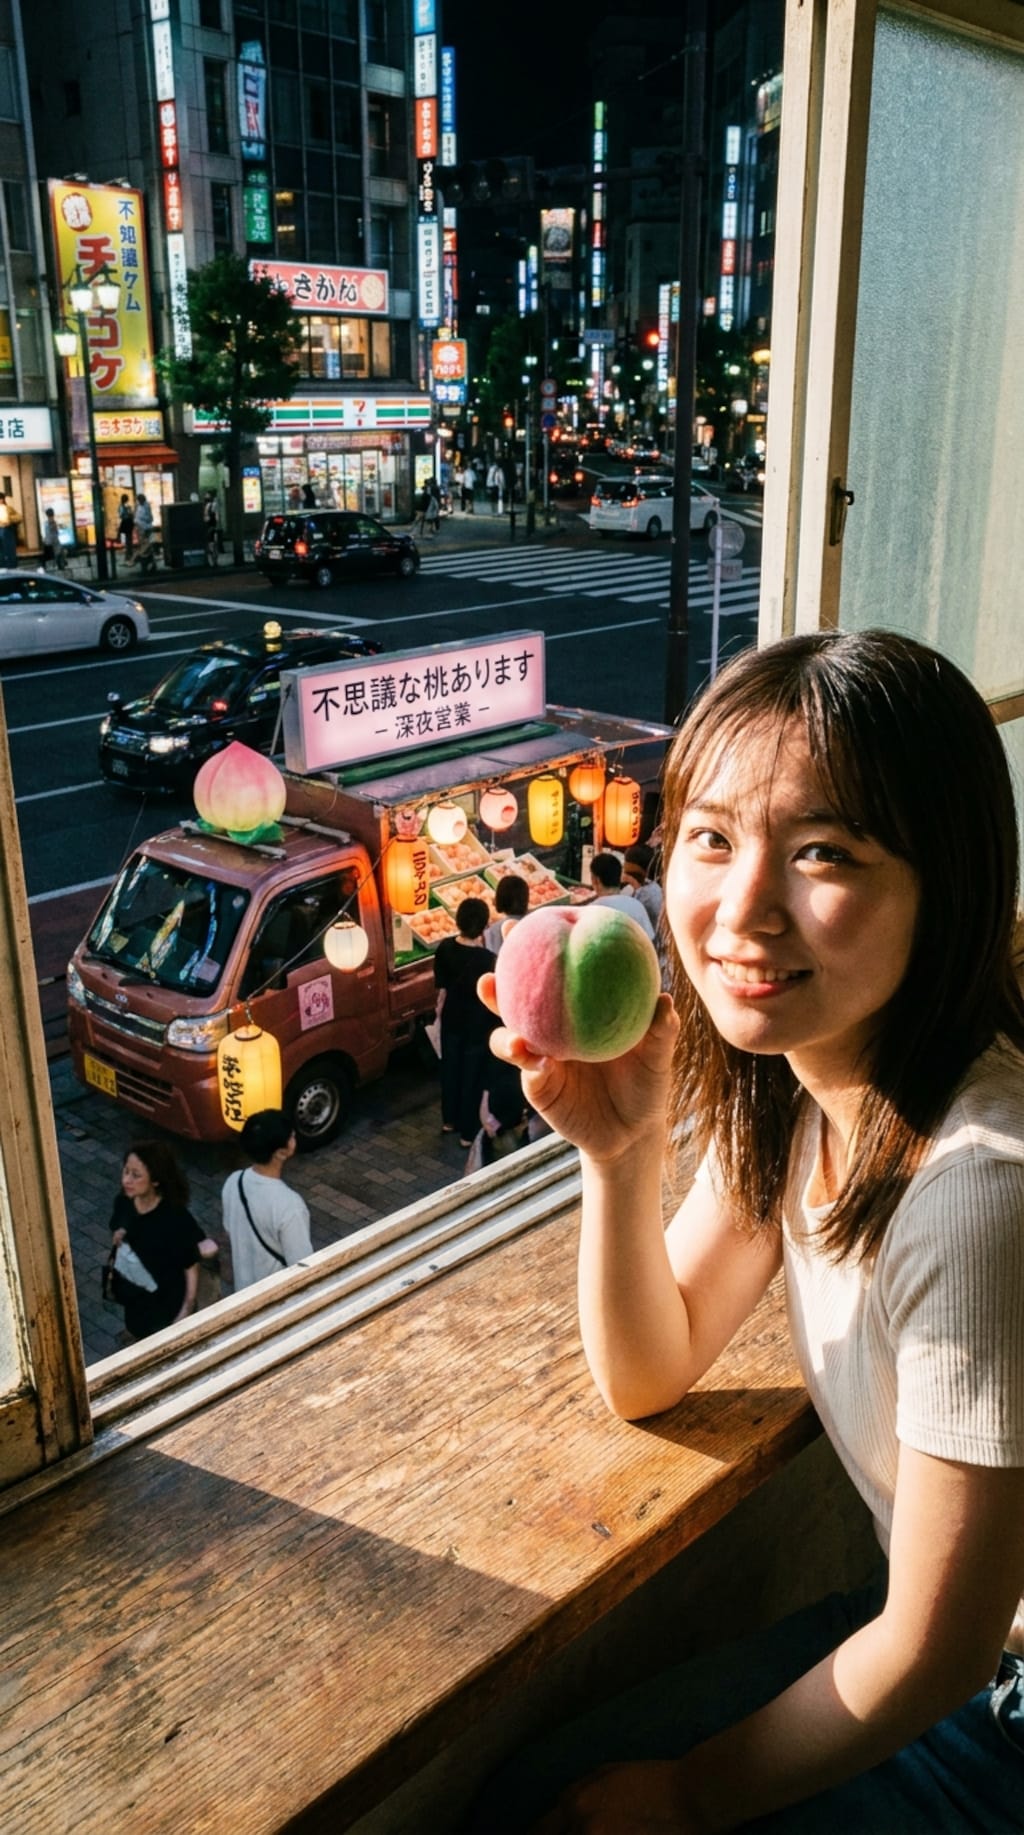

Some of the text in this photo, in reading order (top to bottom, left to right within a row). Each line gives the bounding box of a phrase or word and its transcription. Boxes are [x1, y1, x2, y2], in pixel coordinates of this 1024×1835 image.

[312, 650, 535, 722] 不思議な桃あります
[395, 702, 472, 740] 深夜営業
